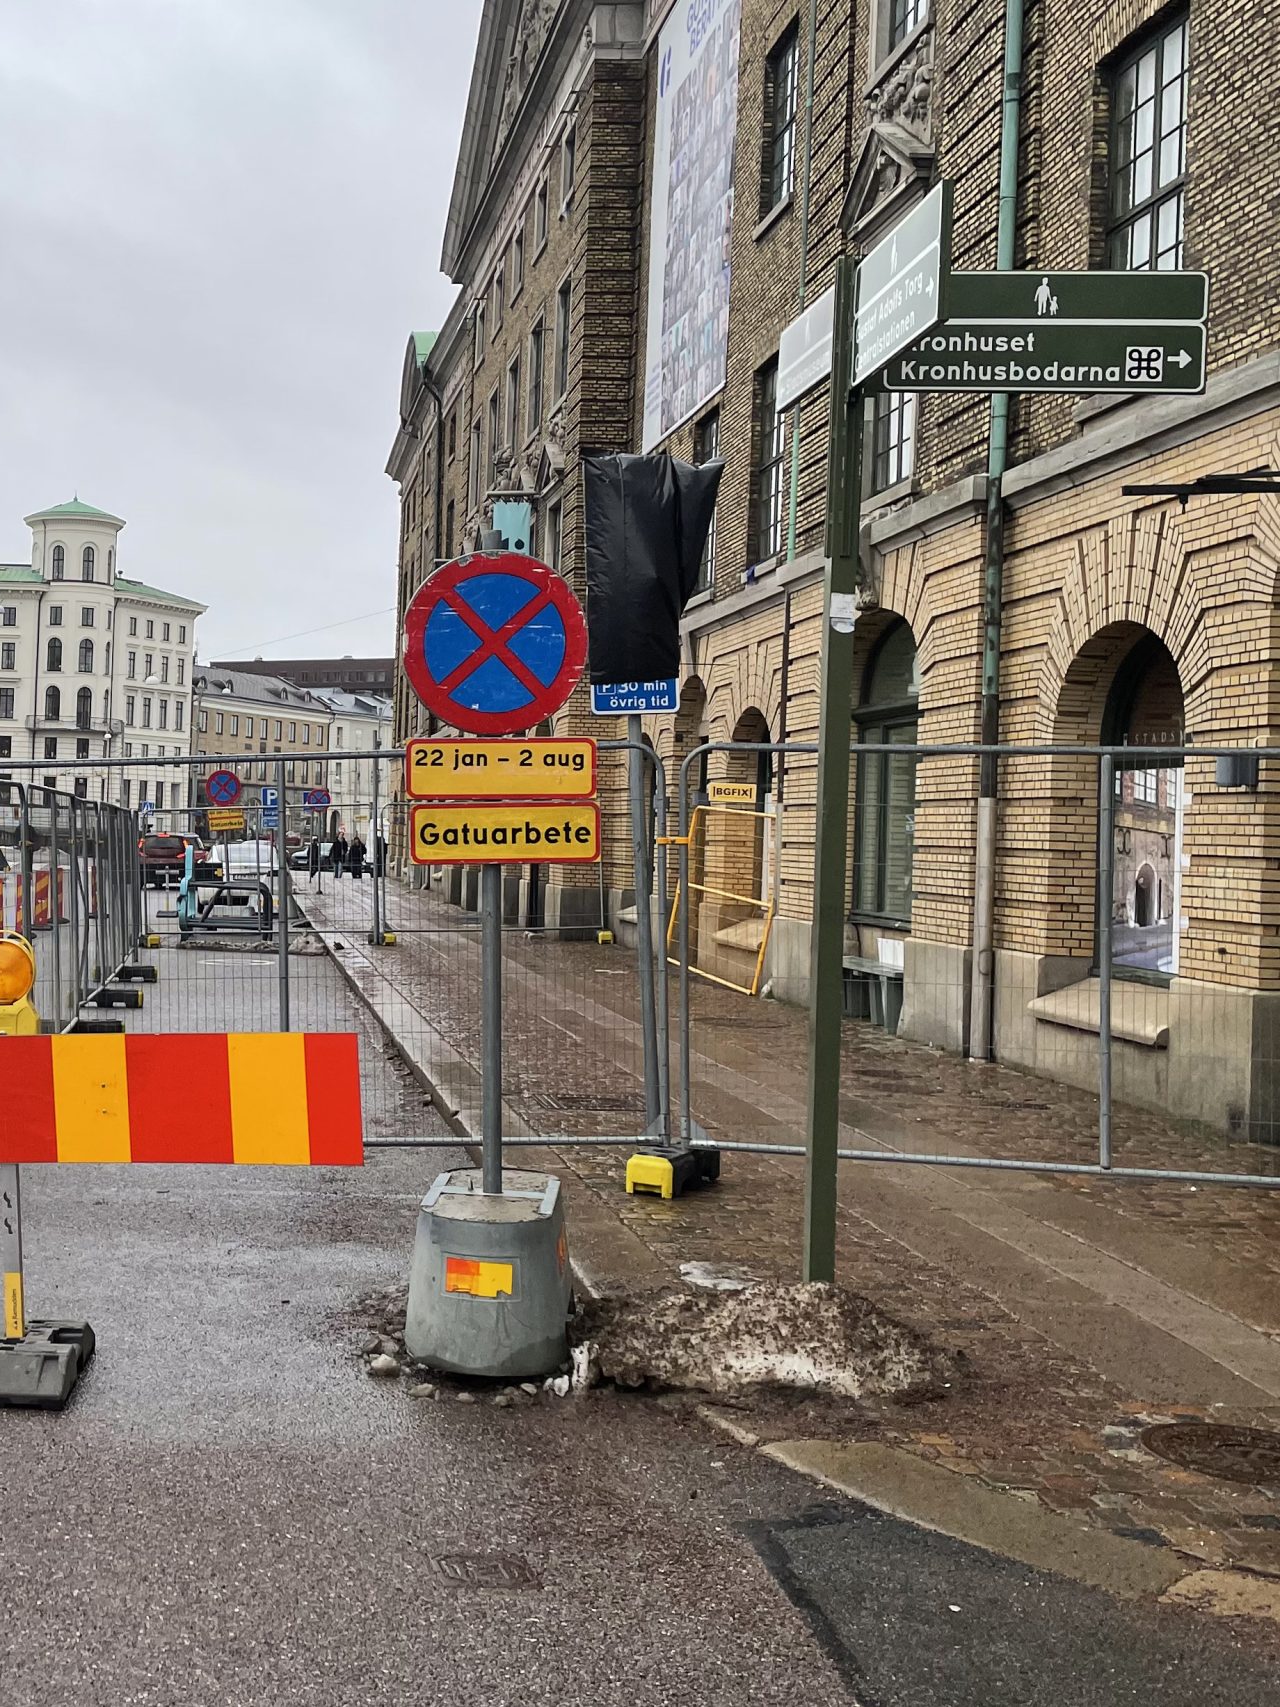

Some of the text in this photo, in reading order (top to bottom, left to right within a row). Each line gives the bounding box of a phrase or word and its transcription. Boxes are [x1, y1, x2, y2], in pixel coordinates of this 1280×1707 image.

[879, 287, 902, 324] Adolfs
[904, 272, 923, 301] Torg
[855, 310, 915, 373] Centralstationen
[912, 332, 1035, 352] ronhuset
[901, 361, 1121, 382] Kronhusbodarna
[618, 682, 638, 693] 30
[644, 680, 667, 691] min
[610, 695, 669, 709] övrig tid
[415, 749, 443, 767] 22
[453, 749, 488, 771] jan
[520, 749, 533, 766] 2
[543, 753, 584, 771] aug
[419, 821, 591, 846] Gatuarbete
